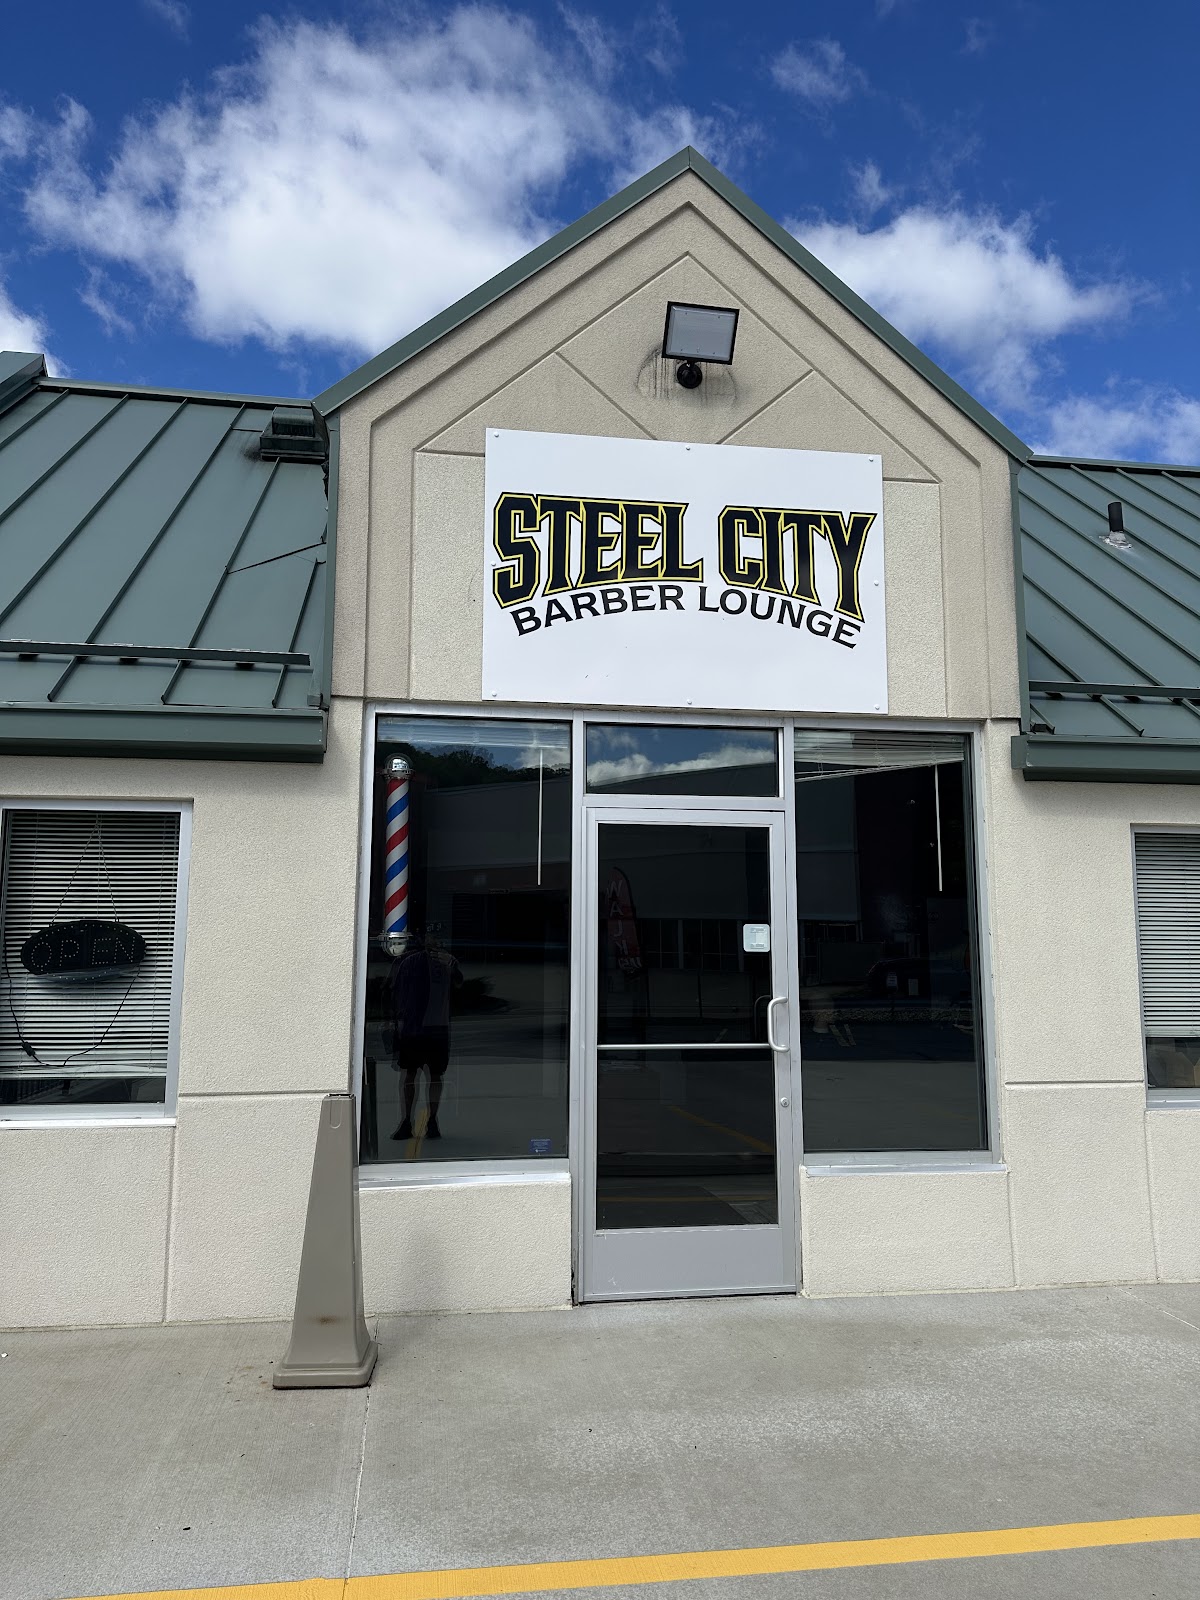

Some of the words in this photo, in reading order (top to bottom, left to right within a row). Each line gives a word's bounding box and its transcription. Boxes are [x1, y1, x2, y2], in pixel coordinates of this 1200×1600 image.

[493, 491, 703, 608] STEEL
[718, 505, 877, 622] CITY
[510, 585, 685, 636] BARBER
[698, 586, 861, 650] LOUNGE
[31, 937, 136, 967] OPEN
